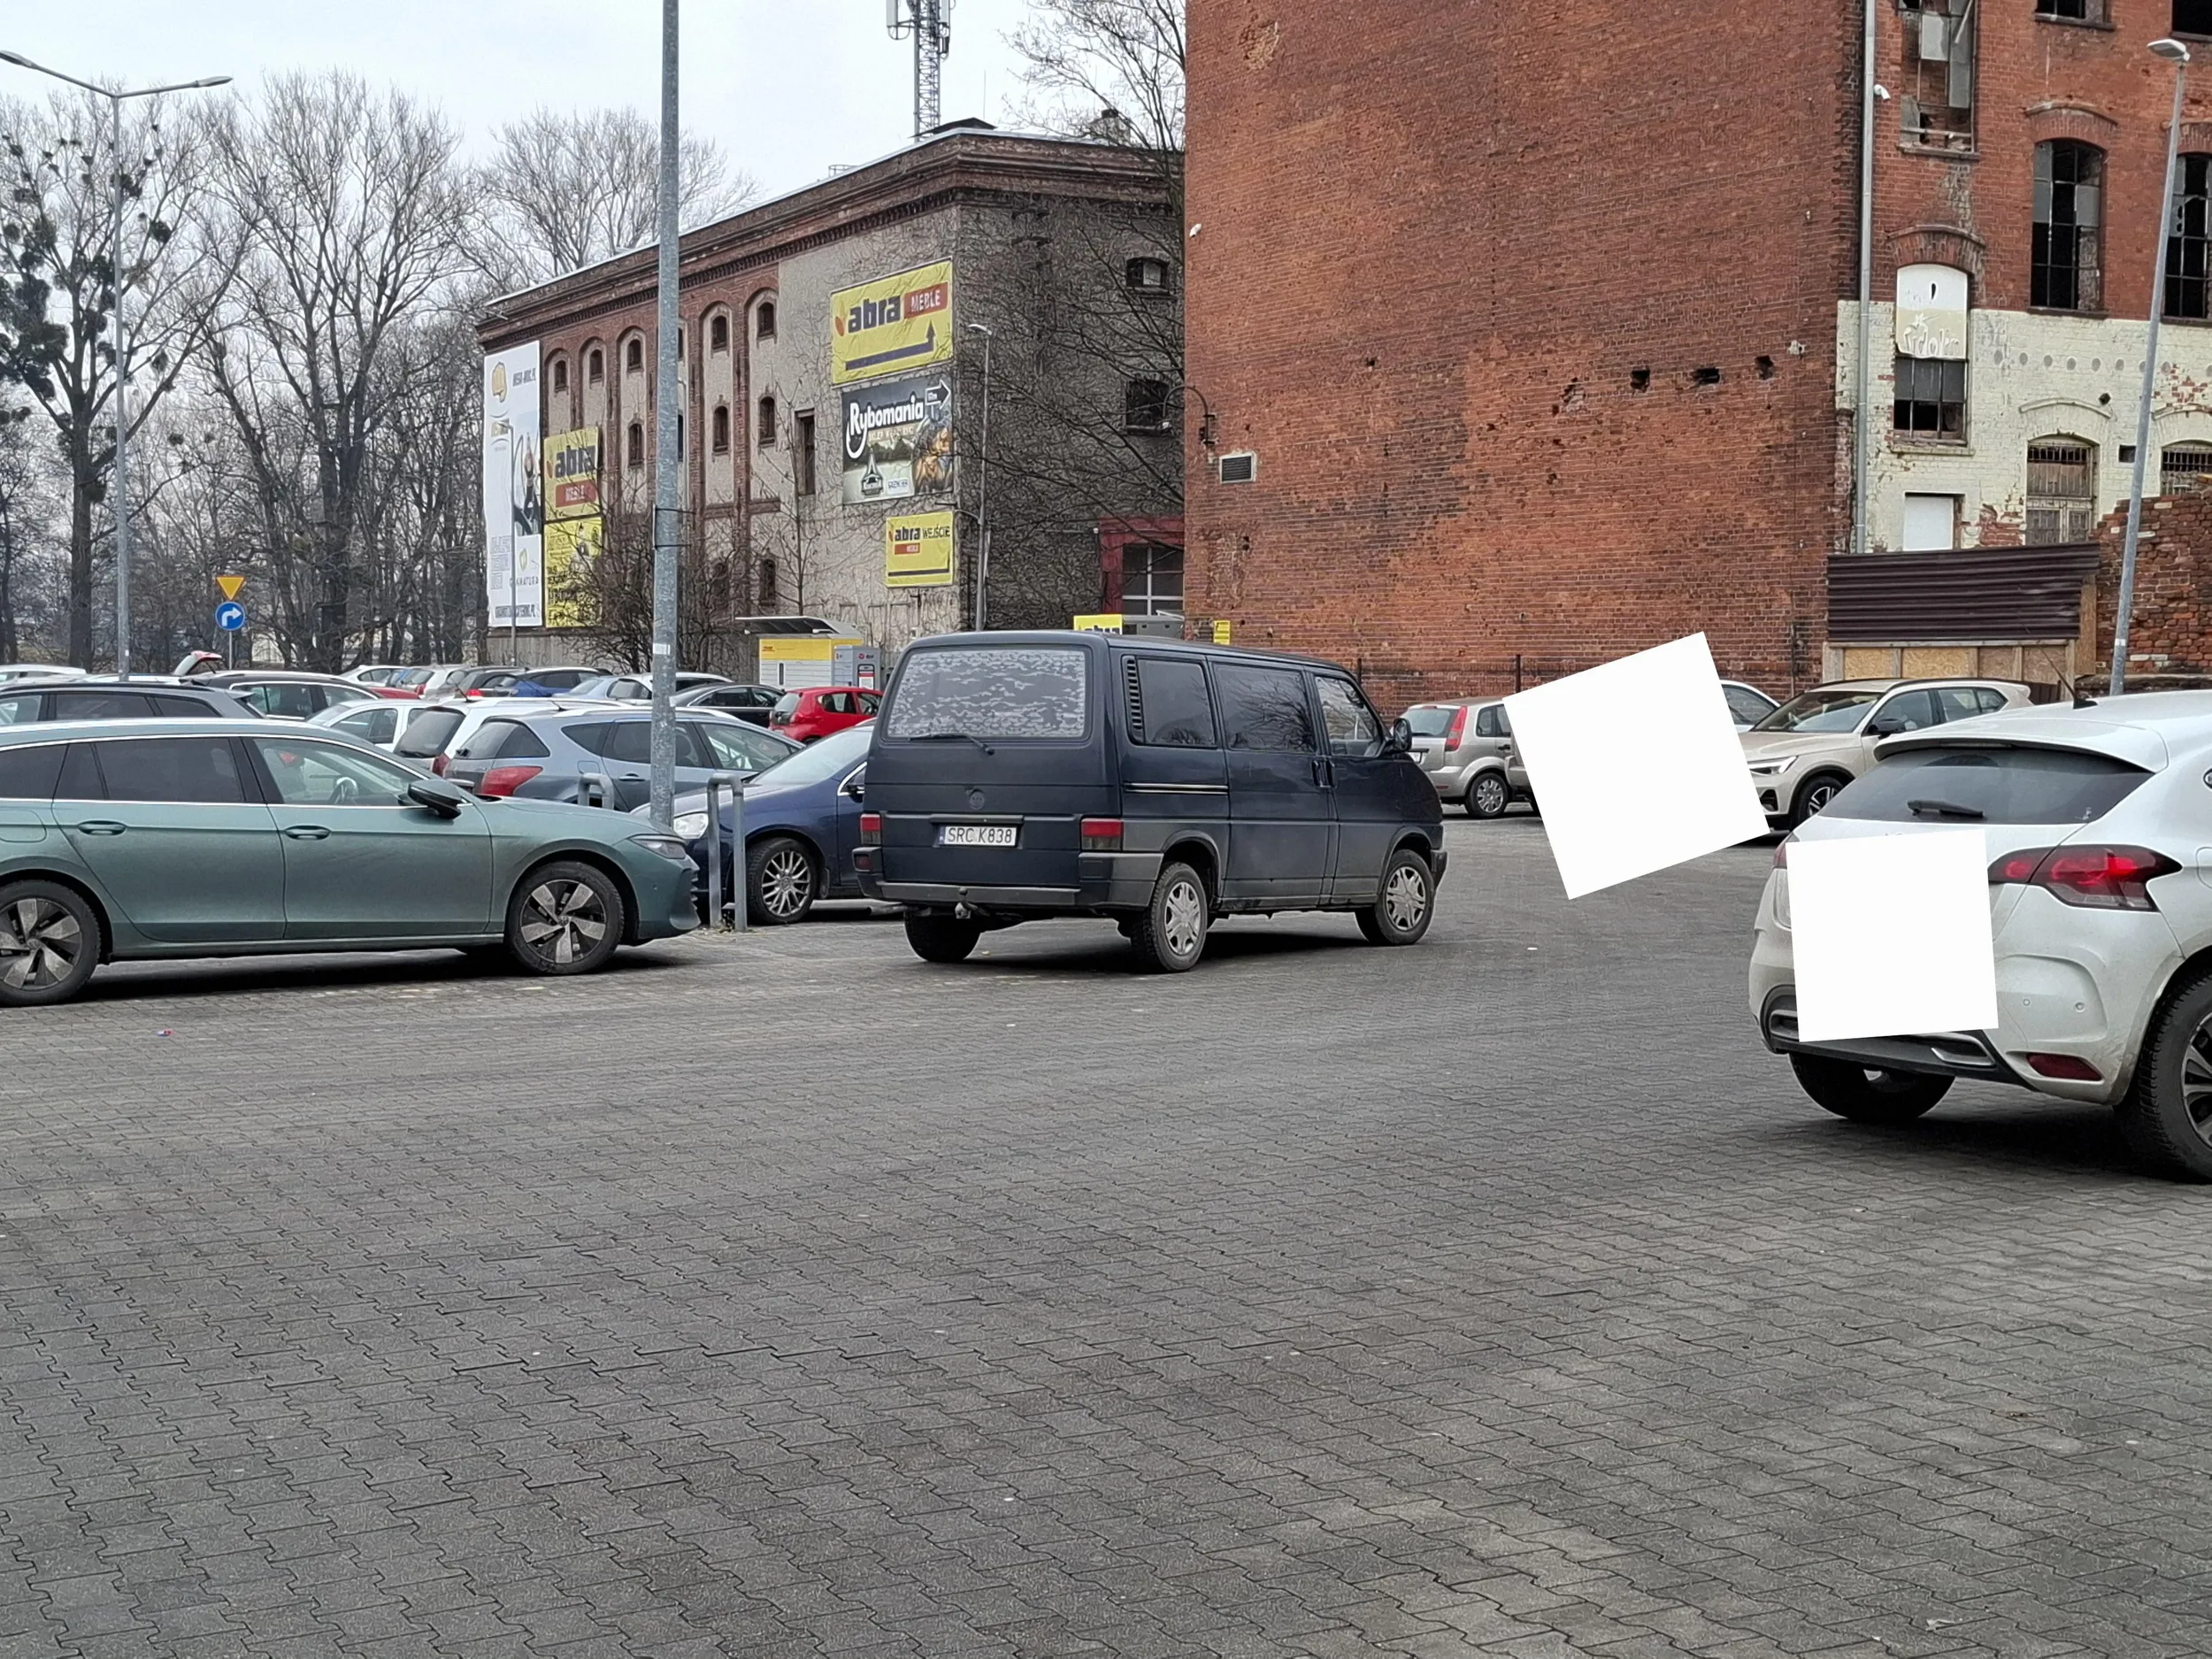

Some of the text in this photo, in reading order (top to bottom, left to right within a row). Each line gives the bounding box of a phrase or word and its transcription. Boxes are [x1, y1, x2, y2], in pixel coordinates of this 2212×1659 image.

[848, 296, 901, 334] abra
[847, 395, 924, 458] Rybomania
[555, 445, 595, 478] abra
[895, 526, 920, 541] abra
[948, 827, 1012, 844] SRC K838
